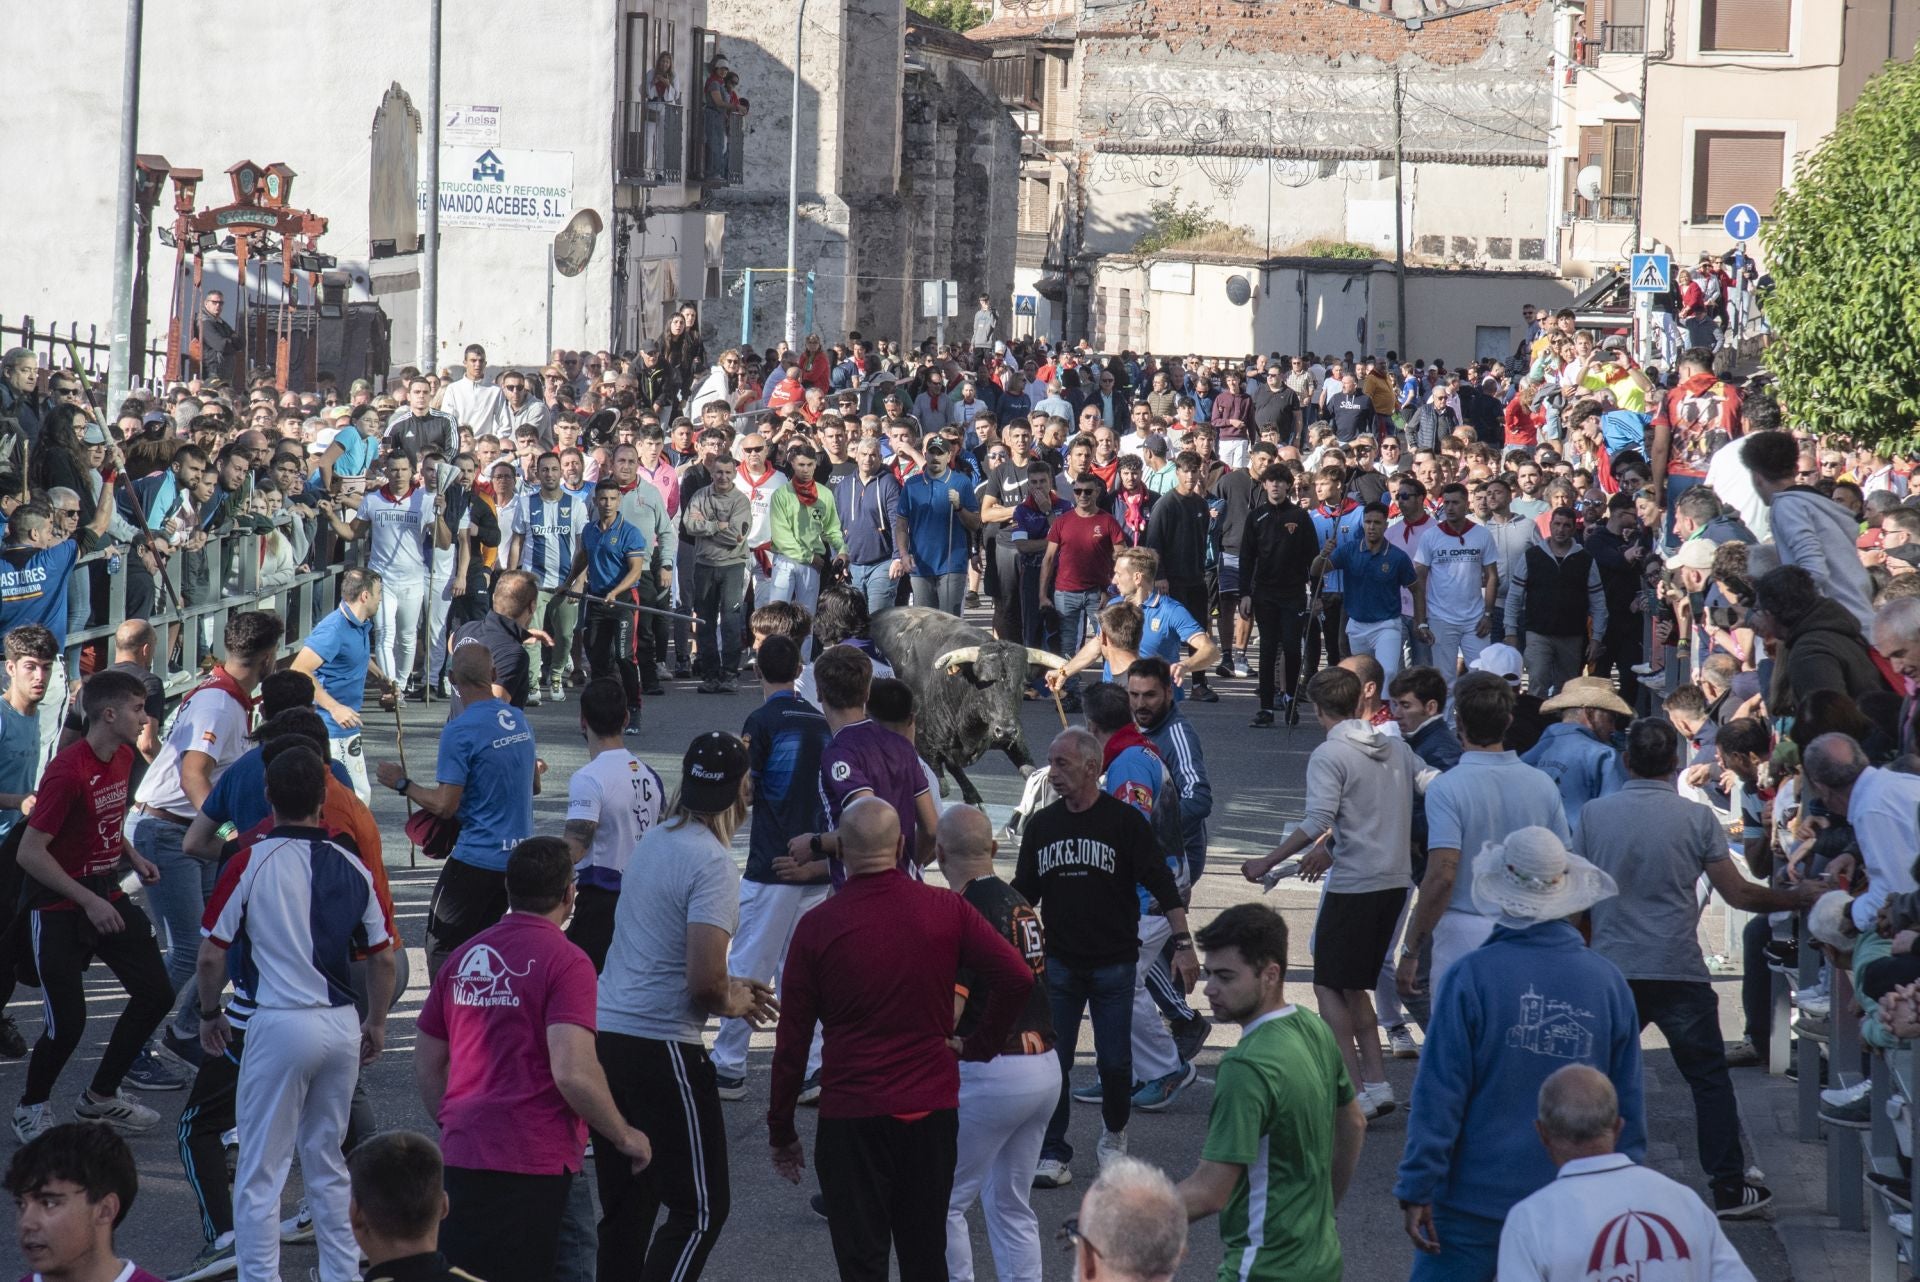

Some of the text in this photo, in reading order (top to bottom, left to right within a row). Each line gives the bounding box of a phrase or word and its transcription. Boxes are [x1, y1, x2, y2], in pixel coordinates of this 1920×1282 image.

[417, 181, 566, 197] OTRUCCIONES Y REFORMAS
[417, 192, 483, 213] HENANDO
[486, 196, 539, 219] ACEBES,
[544, 199, 565, 217] S.L.
[531, 524, 570, 535] Ontime
[0, 566, 46, 587] ASTORES
[502, 838, 525, 851] LA
[1037, 838, 1116, 877] JACK&JONES
[1021, 920, 1041, 953] 15
